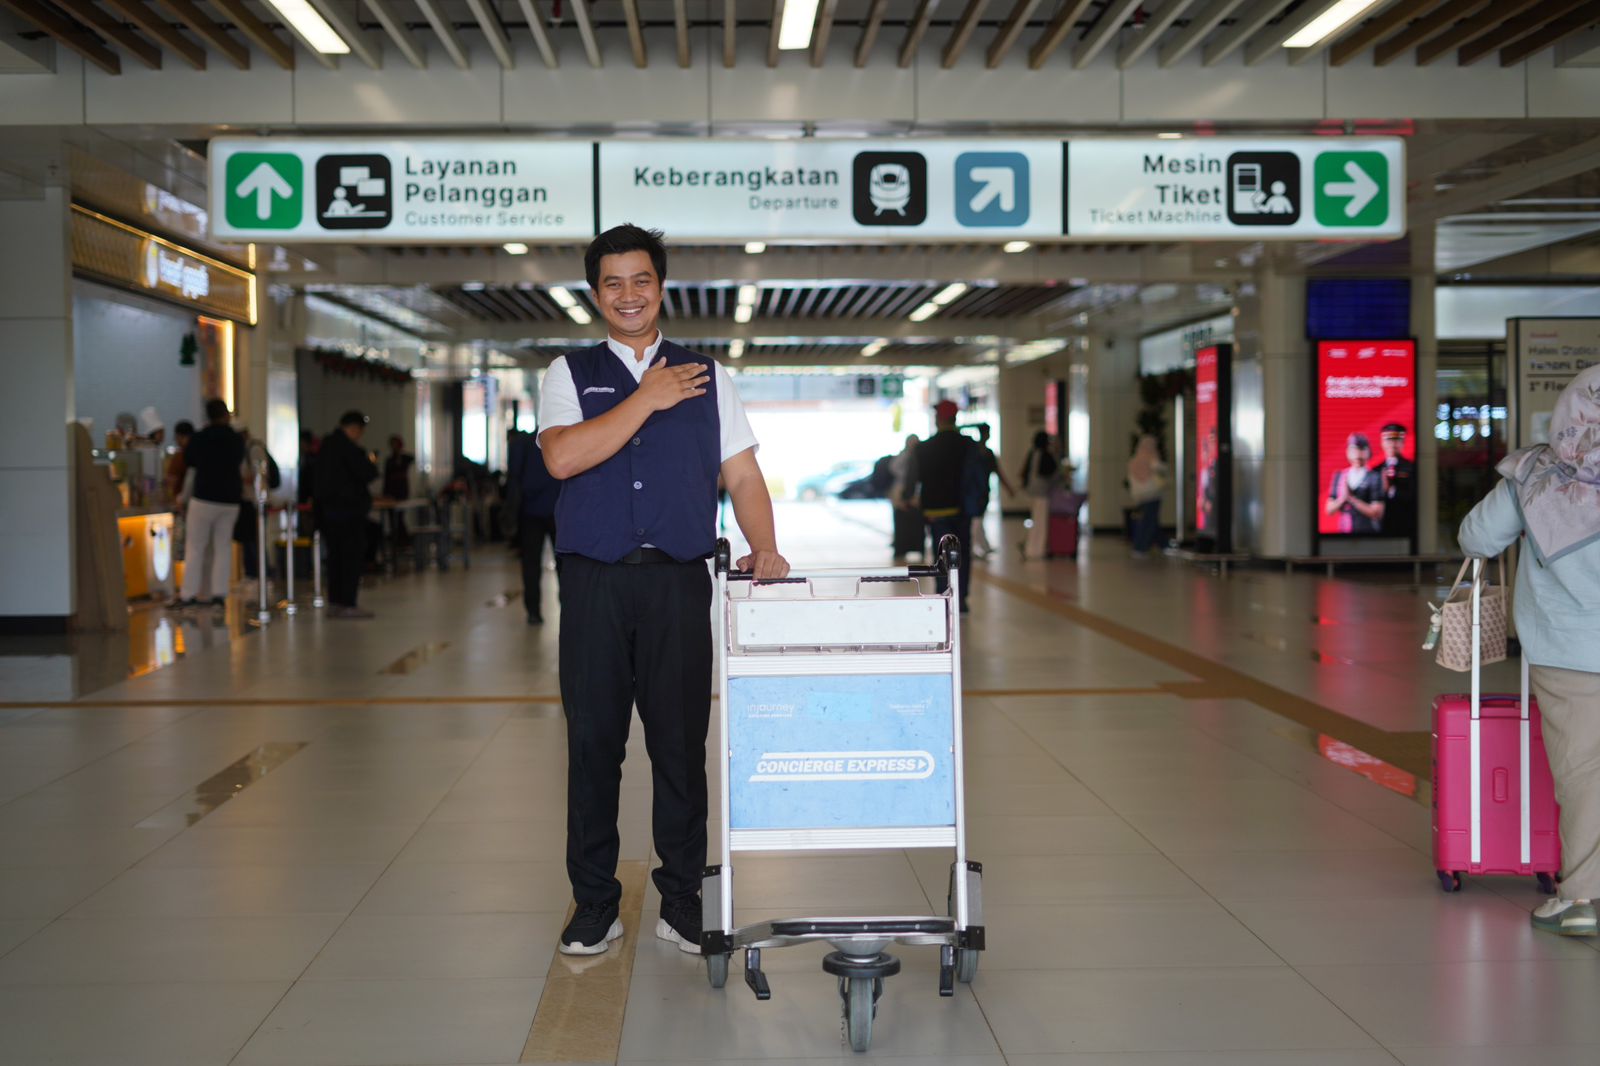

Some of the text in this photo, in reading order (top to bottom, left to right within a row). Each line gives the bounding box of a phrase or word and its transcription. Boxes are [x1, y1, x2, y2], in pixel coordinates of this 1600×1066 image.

[405, 157, 517, 180] Layanan
[1143, 154, 1222, 174] Mesin
[634, 167, 839, 191] Keberangkatan
[405, 183, 547, 208] Pelanggan
[749, 196, 839, 210] Departure
[1155, 185, 1222, 204] Tiket
[405, 211, 565, 226] Customer Service
[1090, 208, 1222, 223] Ticket Machine
[756, 758, 916, 774] CONCIERGE EXPRESS
